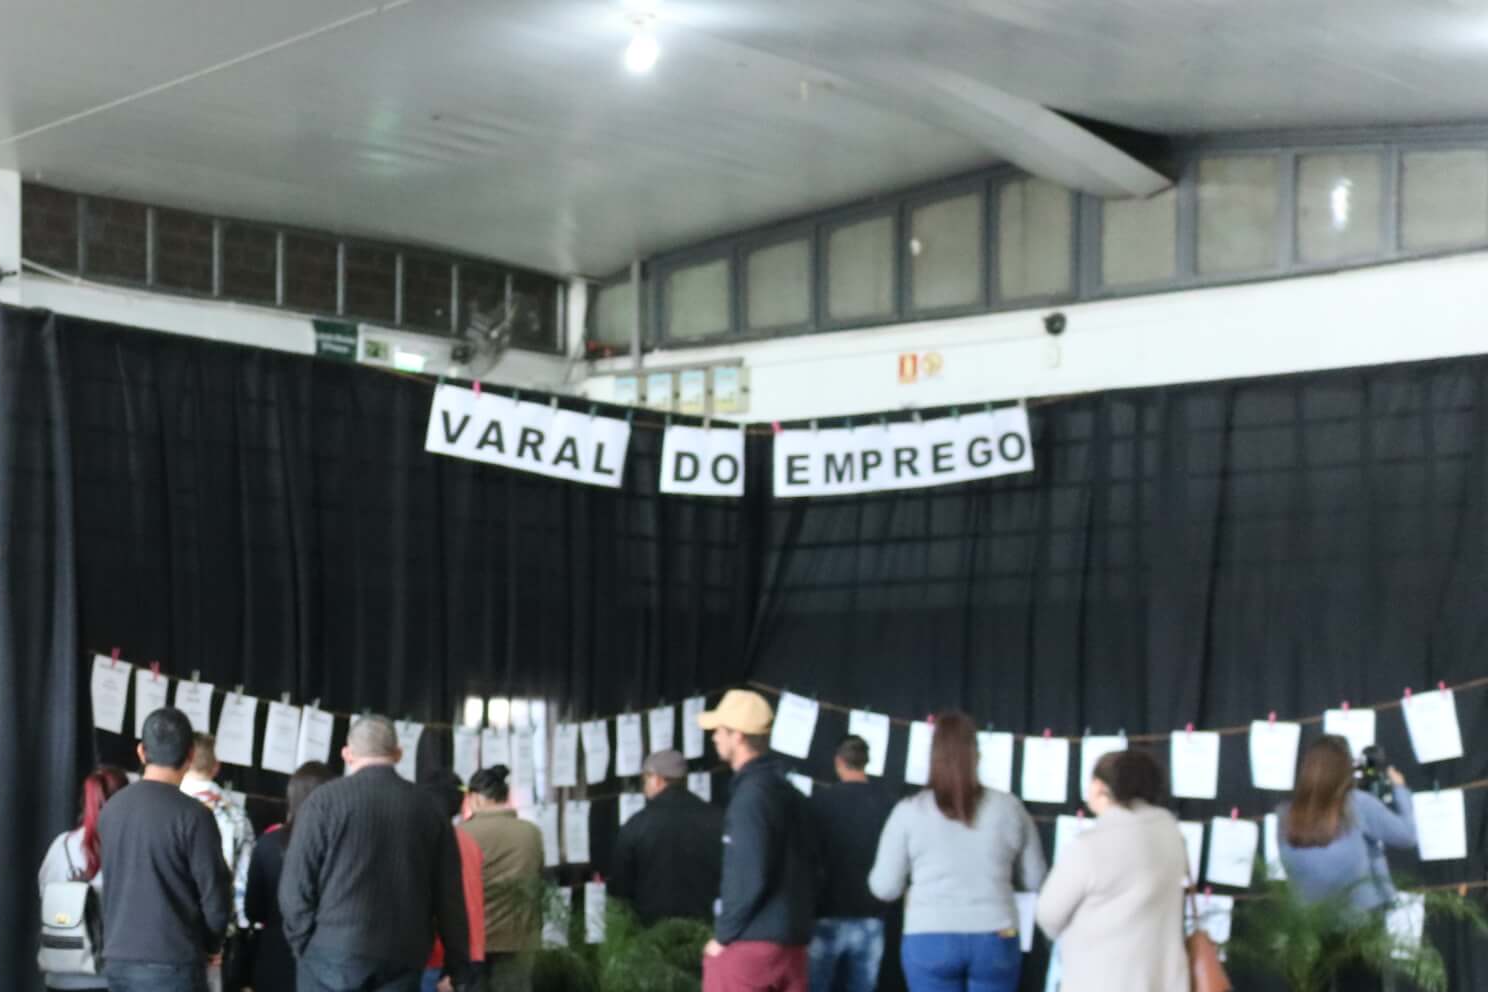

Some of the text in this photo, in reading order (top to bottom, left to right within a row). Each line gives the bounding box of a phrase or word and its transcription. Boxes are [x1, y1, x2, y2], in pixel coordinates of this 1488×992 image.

[440, 410, 1027, 487] VARAL DO EMPREGO
